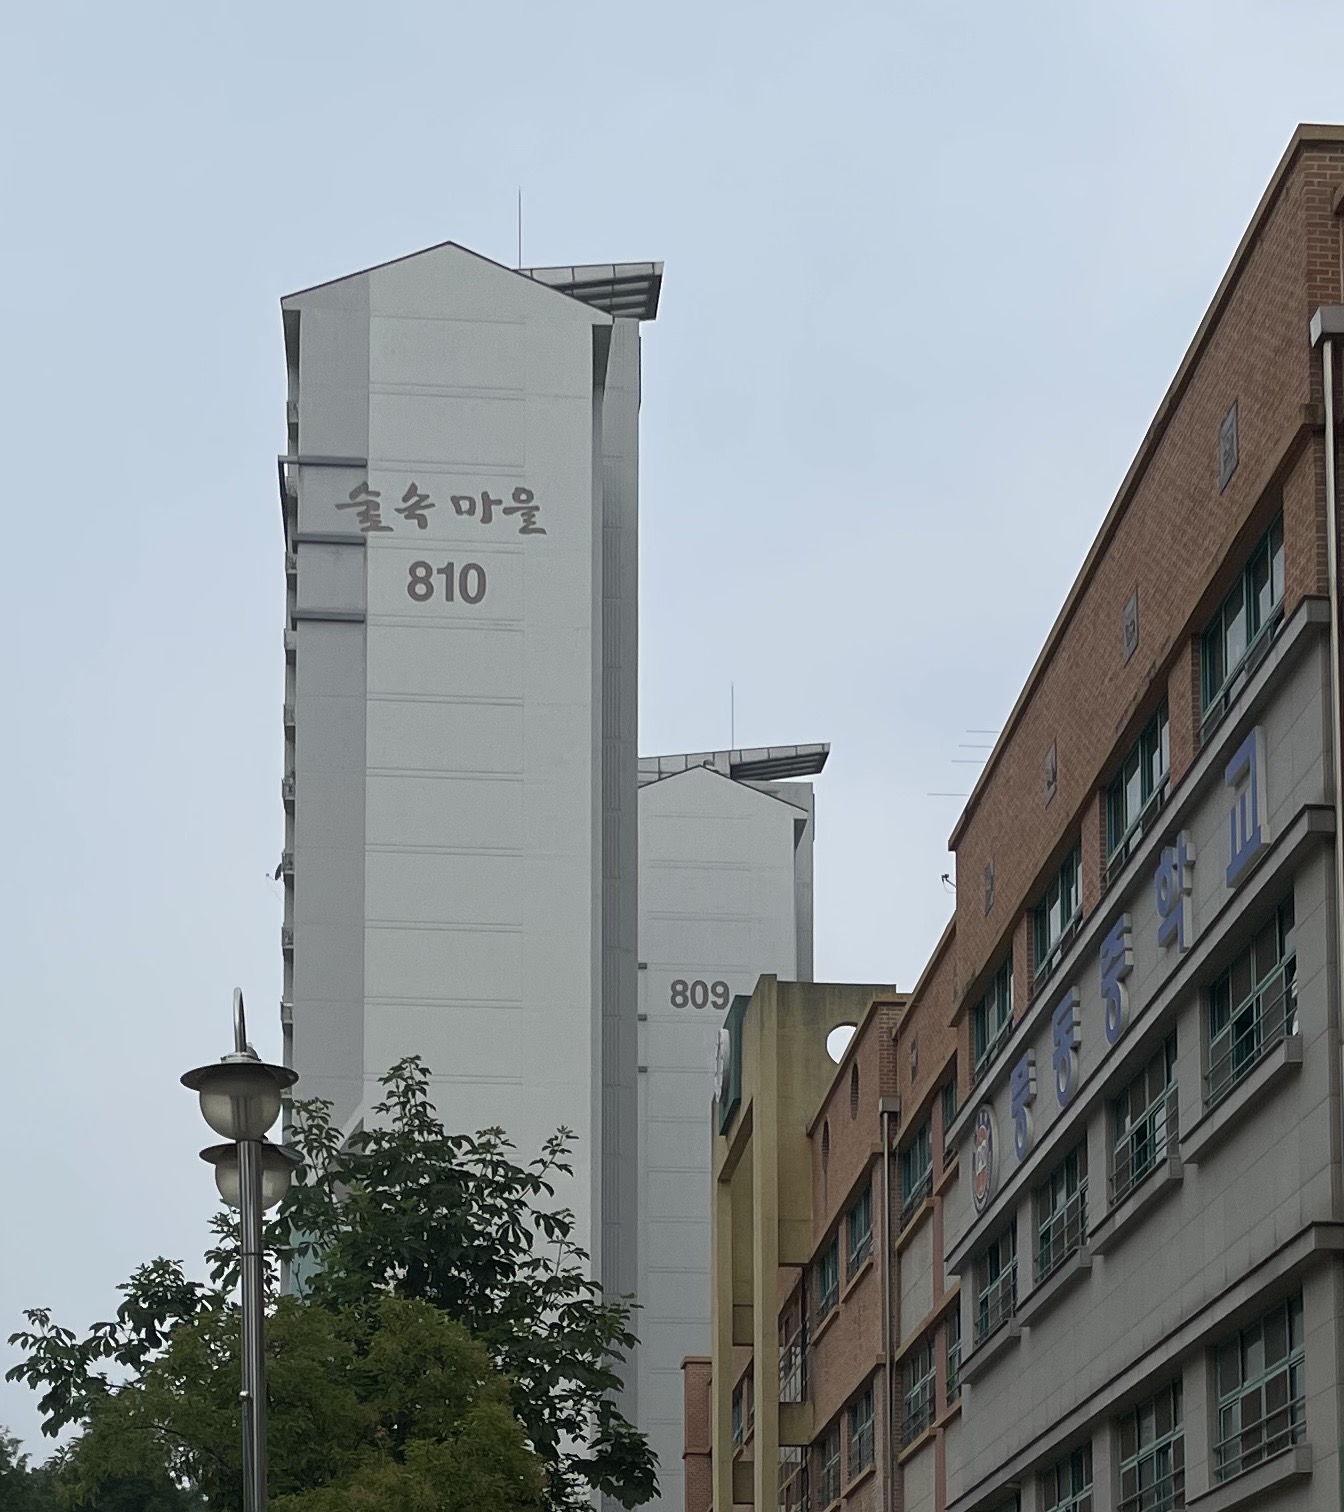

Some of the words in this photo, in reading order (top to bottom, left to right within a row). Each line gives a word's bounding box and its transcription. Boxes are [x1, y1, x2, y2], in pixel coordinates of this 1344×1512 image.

[450, 487, 547, 535] 마을
[407, 560, 487, 604] 810
[1010, 725, 1272, 1162] 풍동중학교
[670, 980, 730, 1010] 809
